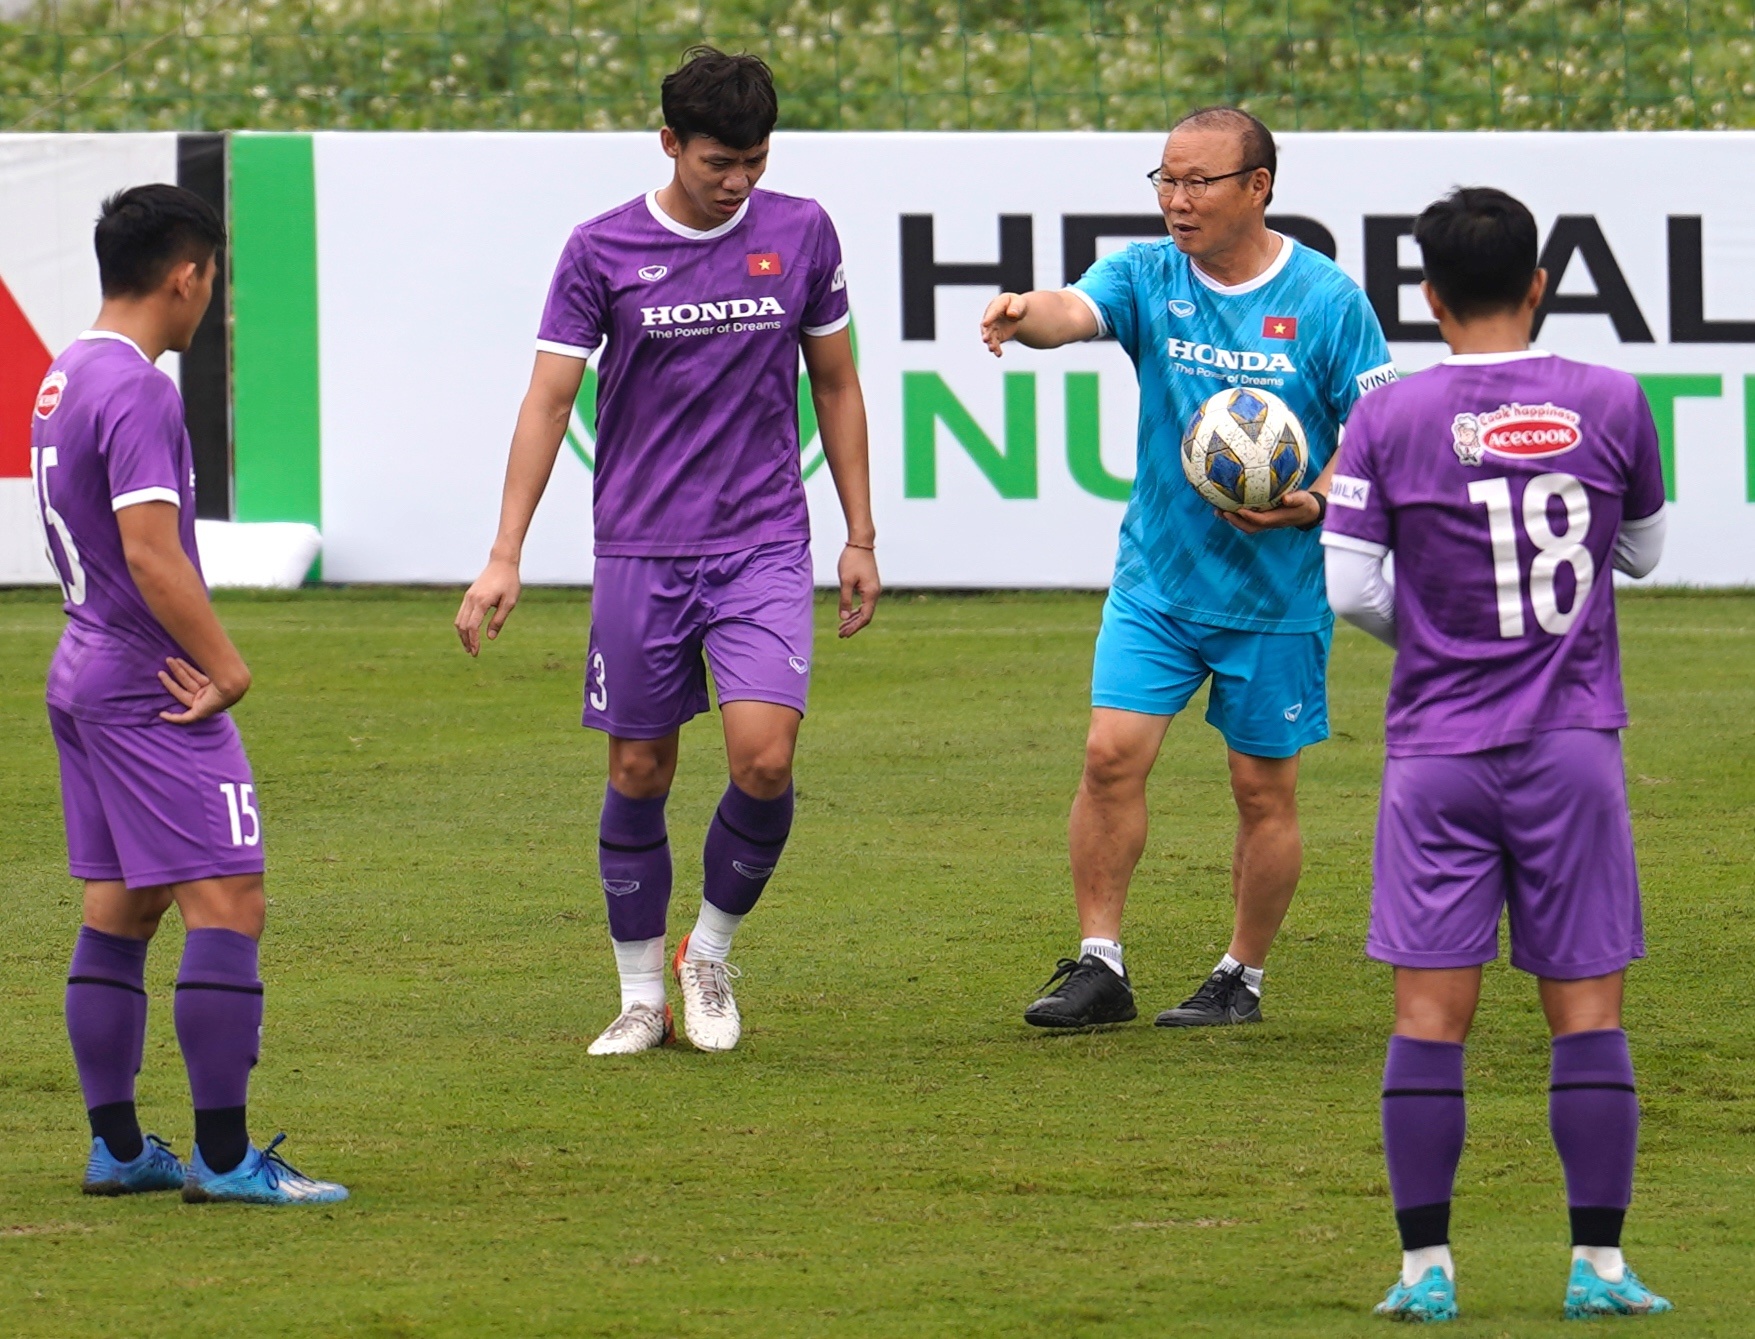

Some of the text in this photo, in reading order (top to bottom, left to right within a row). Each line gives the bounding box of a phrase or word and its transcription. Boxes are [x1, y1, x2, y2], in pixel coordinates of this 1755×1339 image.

[902, 213, 1755, 343] HAL
[640, 297, 785, 326] HONDA
[648, 320, 781, 340] The Power of Dreams
[1168, 338, 1296, 372] HONDA
[1174, 363, 1195, 376] The
[1227, 374, 1239, 384] of
[1241, 375, 1284, 387] Dreams
[1467, 473, 1594, 638] 18
[590, 653, 607, 711] 3
[219, 783, 259, 846] 15
